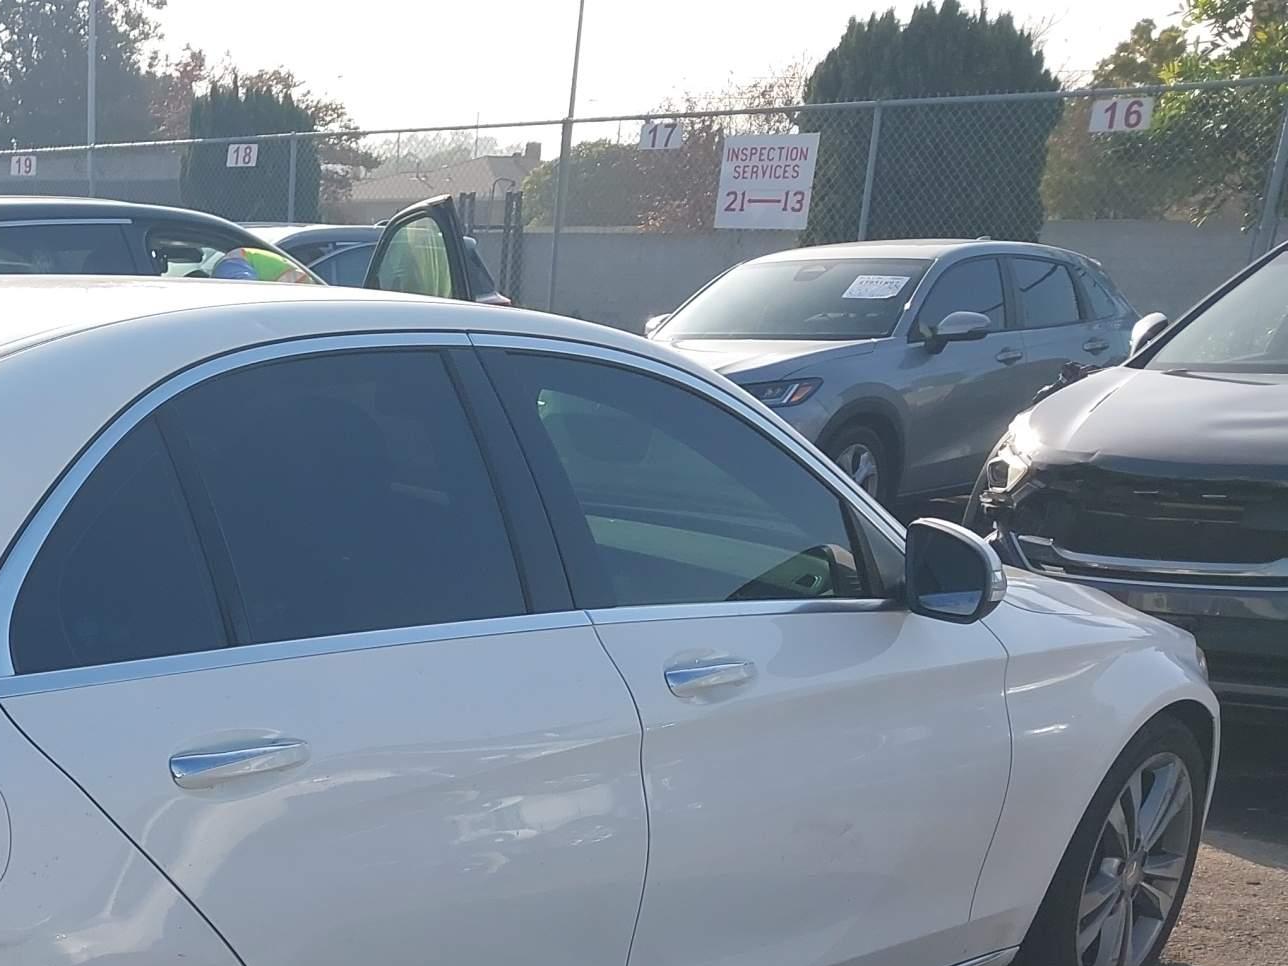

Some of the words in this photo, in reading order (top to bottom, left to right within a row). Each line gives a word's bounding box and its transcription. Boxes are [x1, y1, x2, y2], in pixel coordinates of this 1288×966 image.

[1104, 100, 1144, 129] 16
[648, 123, 678, 148] 17
[233, 145, 252, 165] 18
[726, 146, 809, 162] INSPECTION
[15, 156, 32, 174] 19
[732, 164, 801, 180] SERVICES
